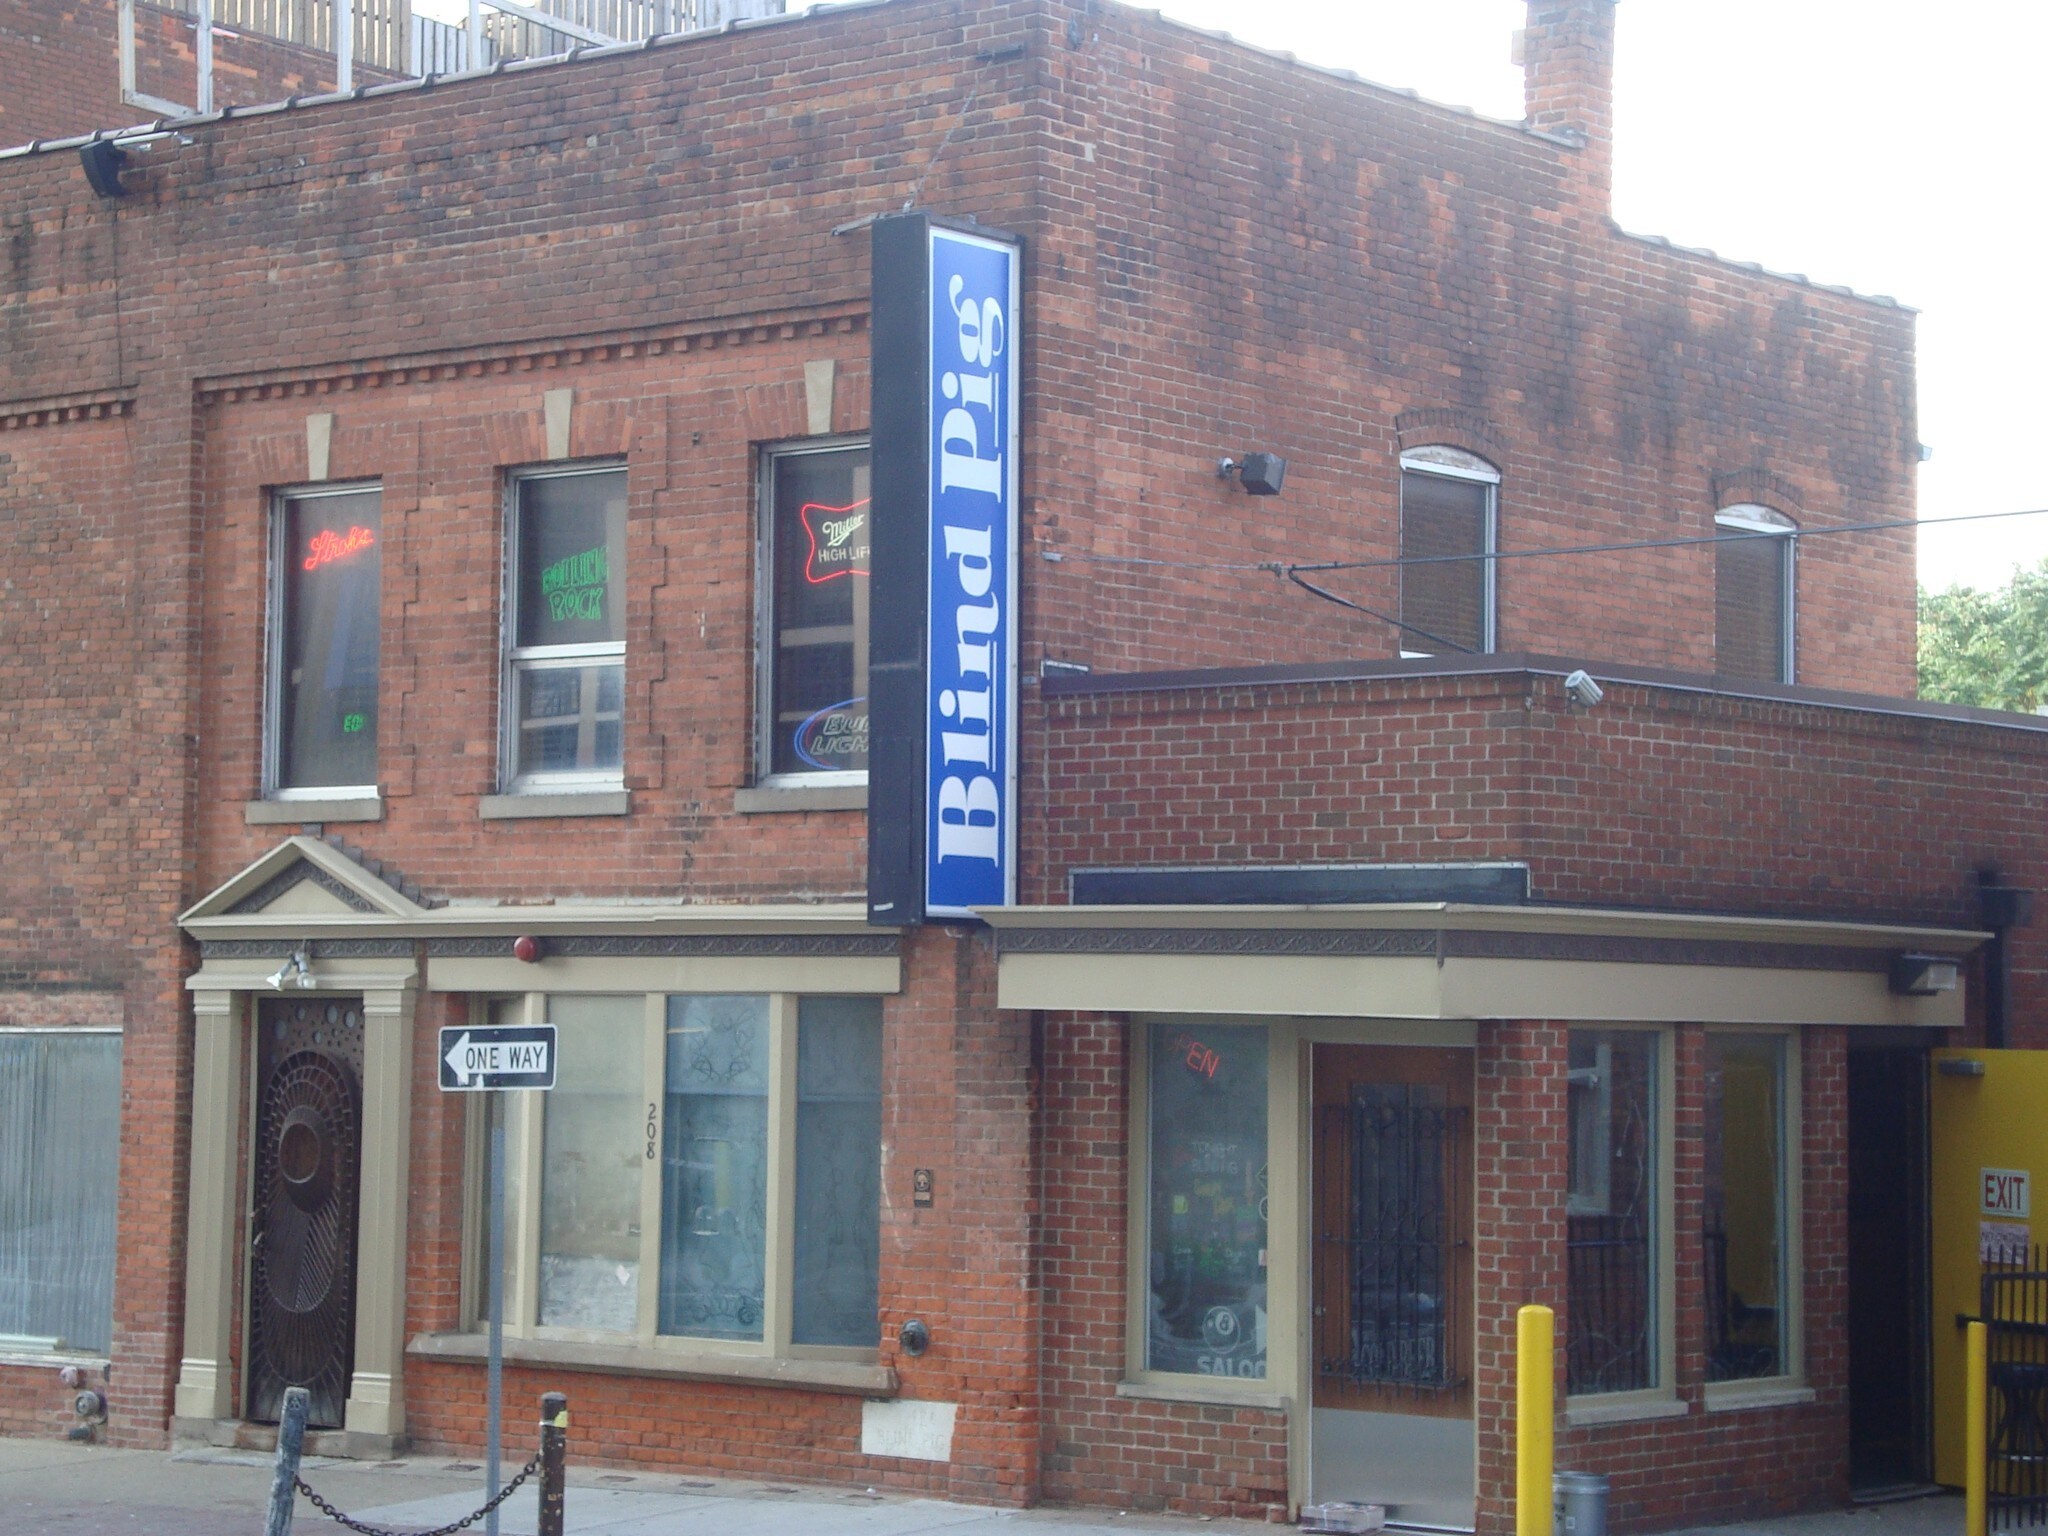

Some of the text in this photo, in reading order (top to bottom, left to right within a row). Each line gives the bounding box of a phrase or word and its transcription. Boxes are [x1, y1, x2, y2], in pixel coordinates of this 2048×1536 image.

[822, 513, 865, 547] Miller
[818, 546, 847, 563] HIGH
[938, 273, 1004, 868] Blind Pig
[549, 589, 603, 621] ROCK
[465, 1045, 545, 1070] ONE WAY
[646, 1103, 657, 1160] 208
[1985, 1175, 2025, 1209] EXIT
